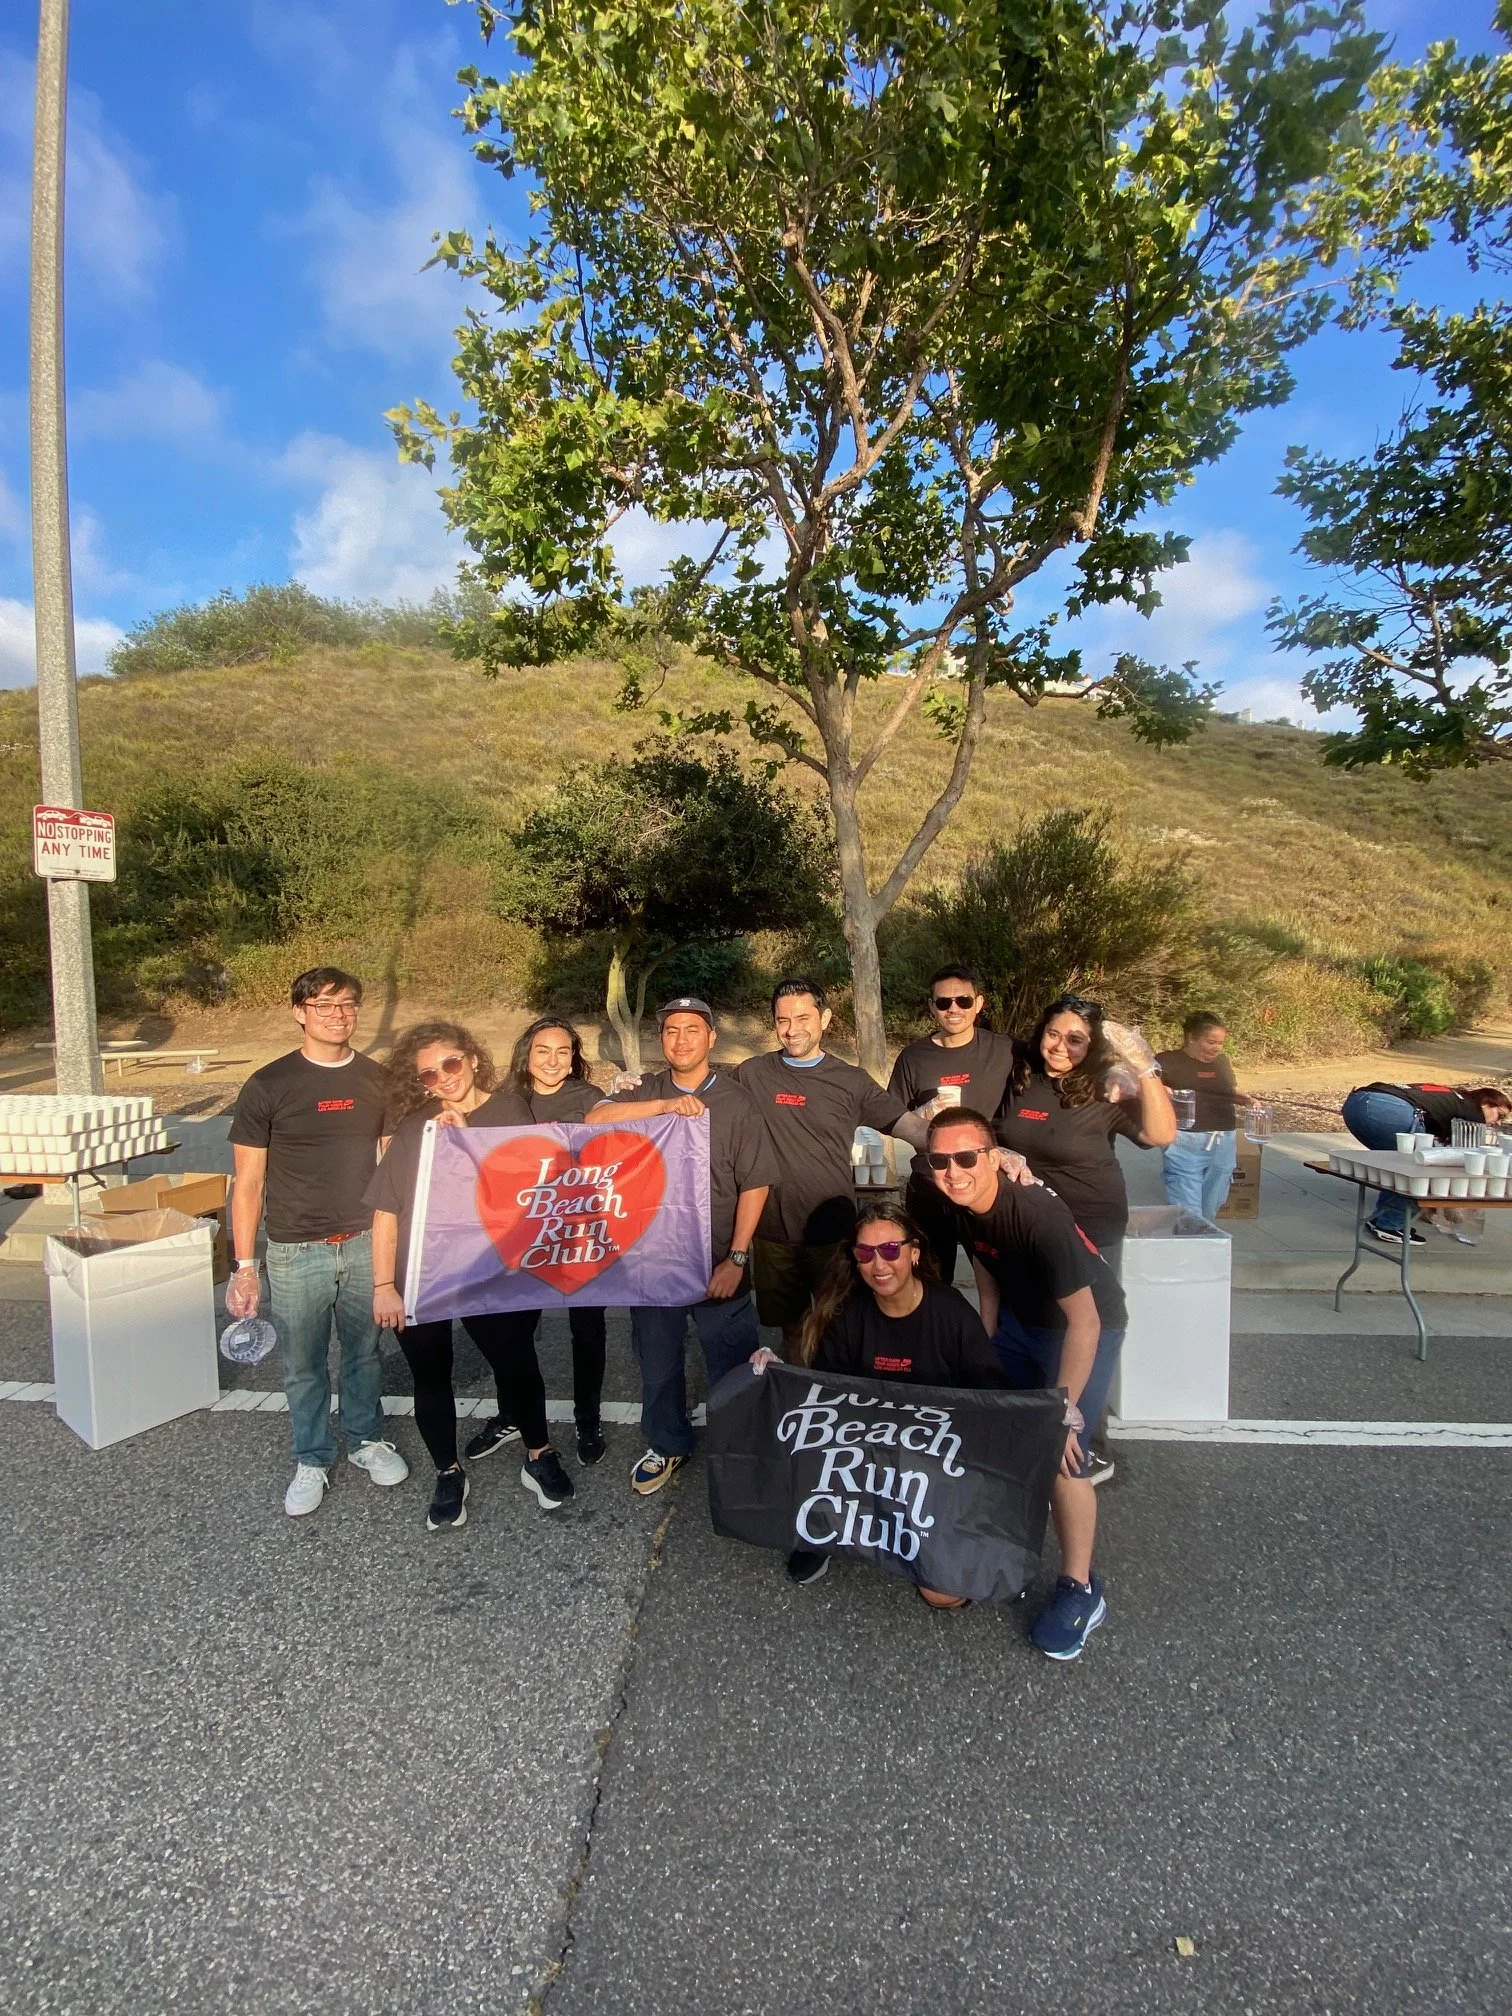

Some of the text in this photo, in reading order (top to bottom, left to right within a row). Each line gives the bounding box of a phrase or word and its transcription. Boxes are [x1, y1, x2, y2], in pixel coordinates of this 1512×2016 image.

[37, 821, 111, 843] NO STOPPING
[41, 841, 111, 860] ANY TIME
[533, 1157, 623, 1190] Long
[516, 1184, 628, 1219] Beach
[531, 1216, 613, 1244] Run
[777, 1407, 965, 1478] Beach
[811, 1446, 935, 1528] Run
